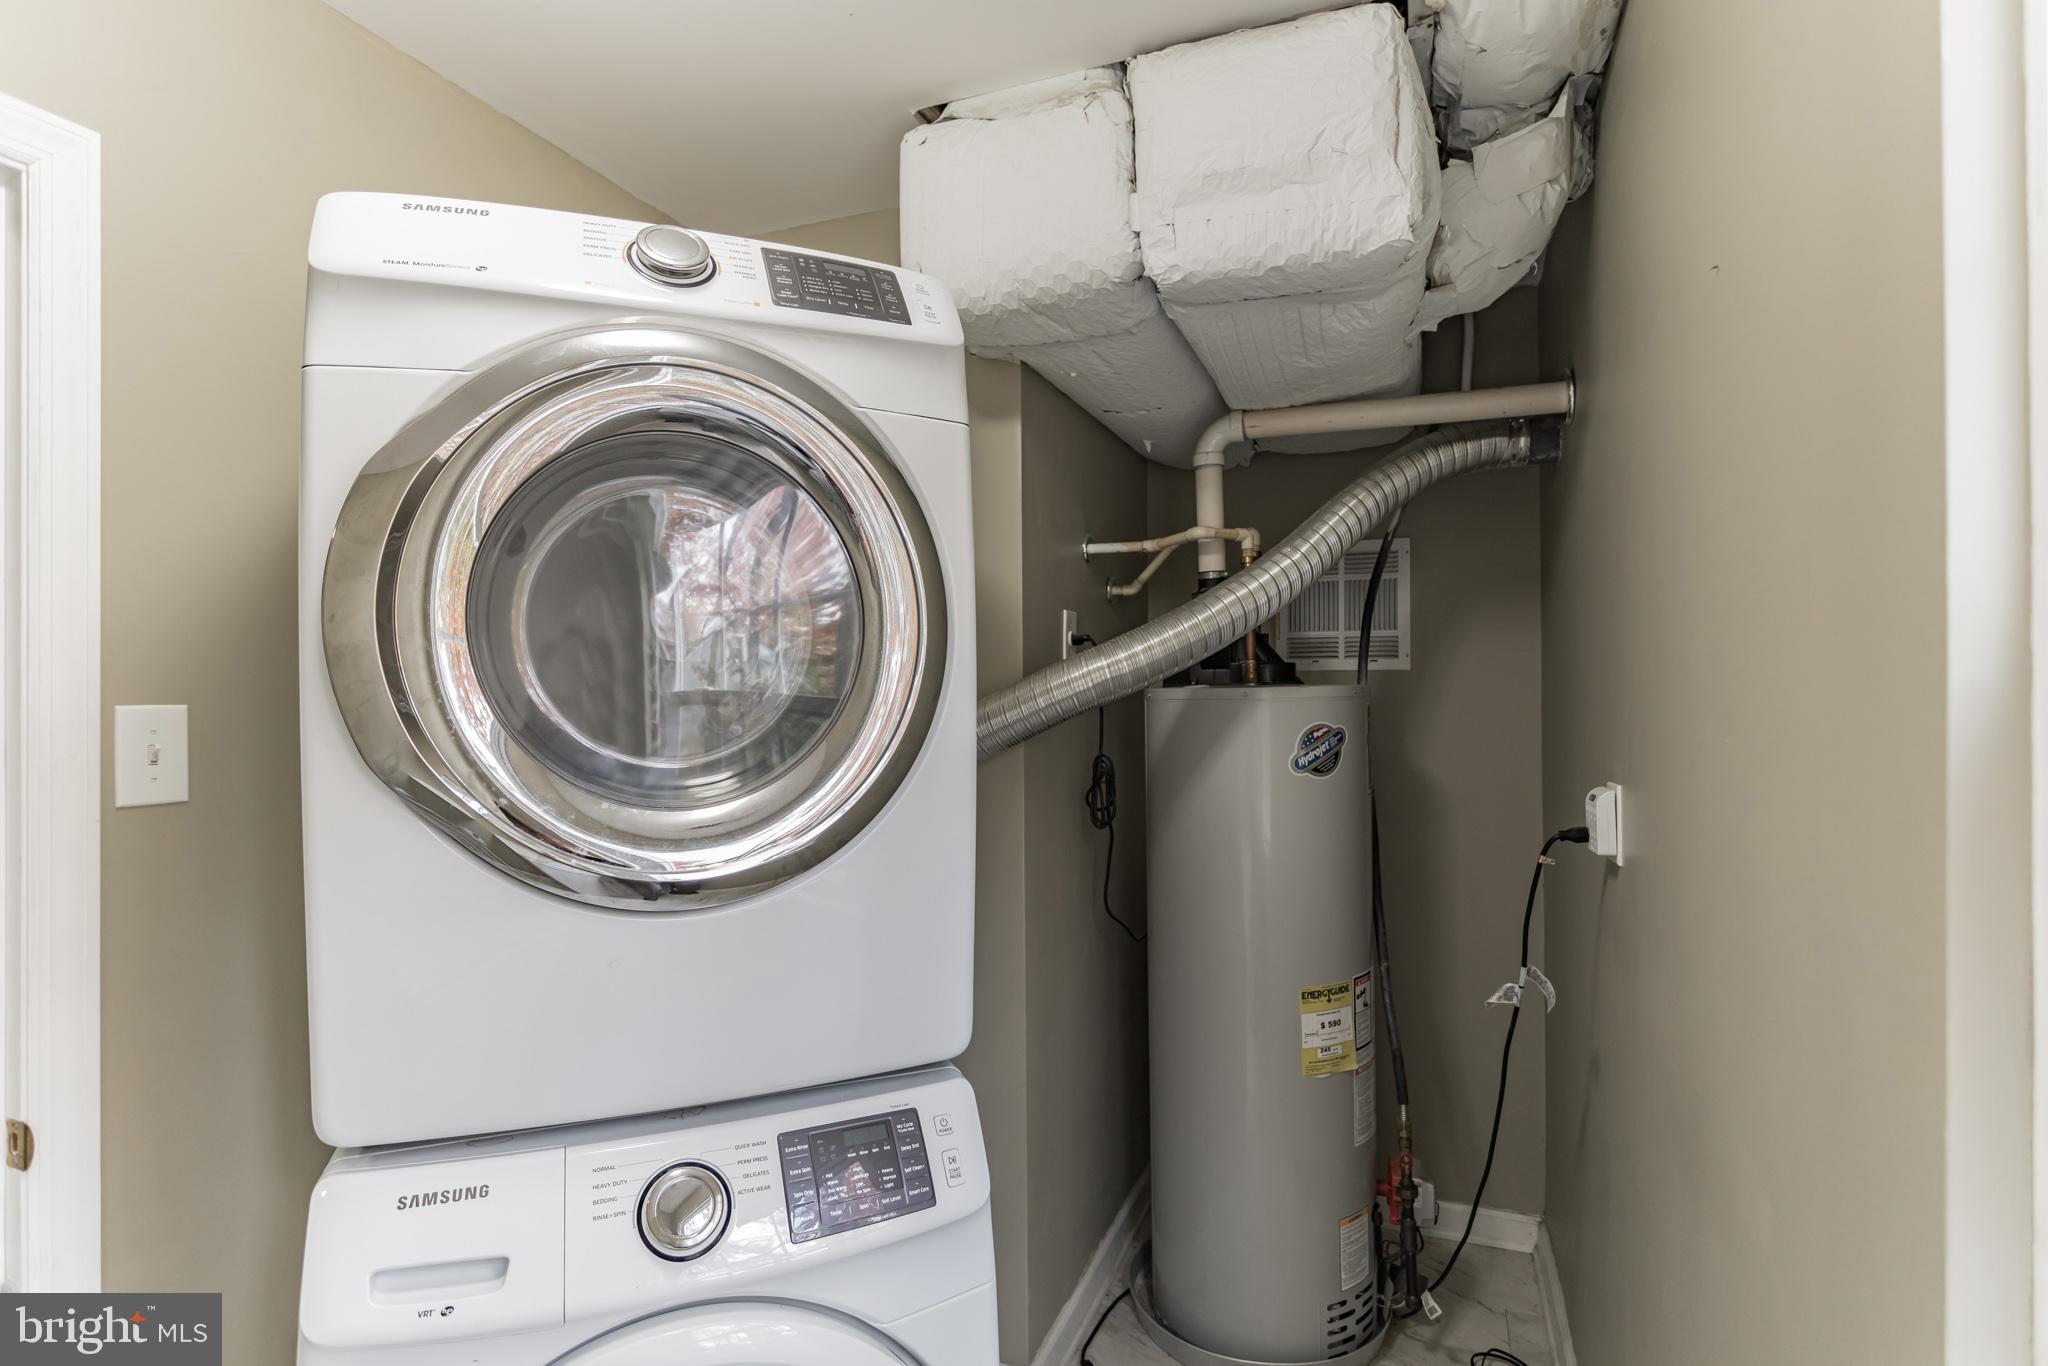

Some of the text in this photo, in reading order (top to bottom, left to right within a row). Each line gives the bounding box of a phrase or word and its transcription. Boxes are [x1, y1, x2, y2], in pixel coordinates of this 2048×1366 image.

[402, 203, 490, 217] SAMSUNG
[1320, 1018, 1342, 1029] $ 590
[592, 1165, 617, 1173] NORMAL
[743, 1170, 770, 1179] DELICATES
[612, 1179, 628, 1187] DUTY
[738, 1184, 772, 1195] ACTIVE WEAR
[397, 1184, 490, 1210] SAMSUNG
[592, 1196, 618, 1206] BEDDING
